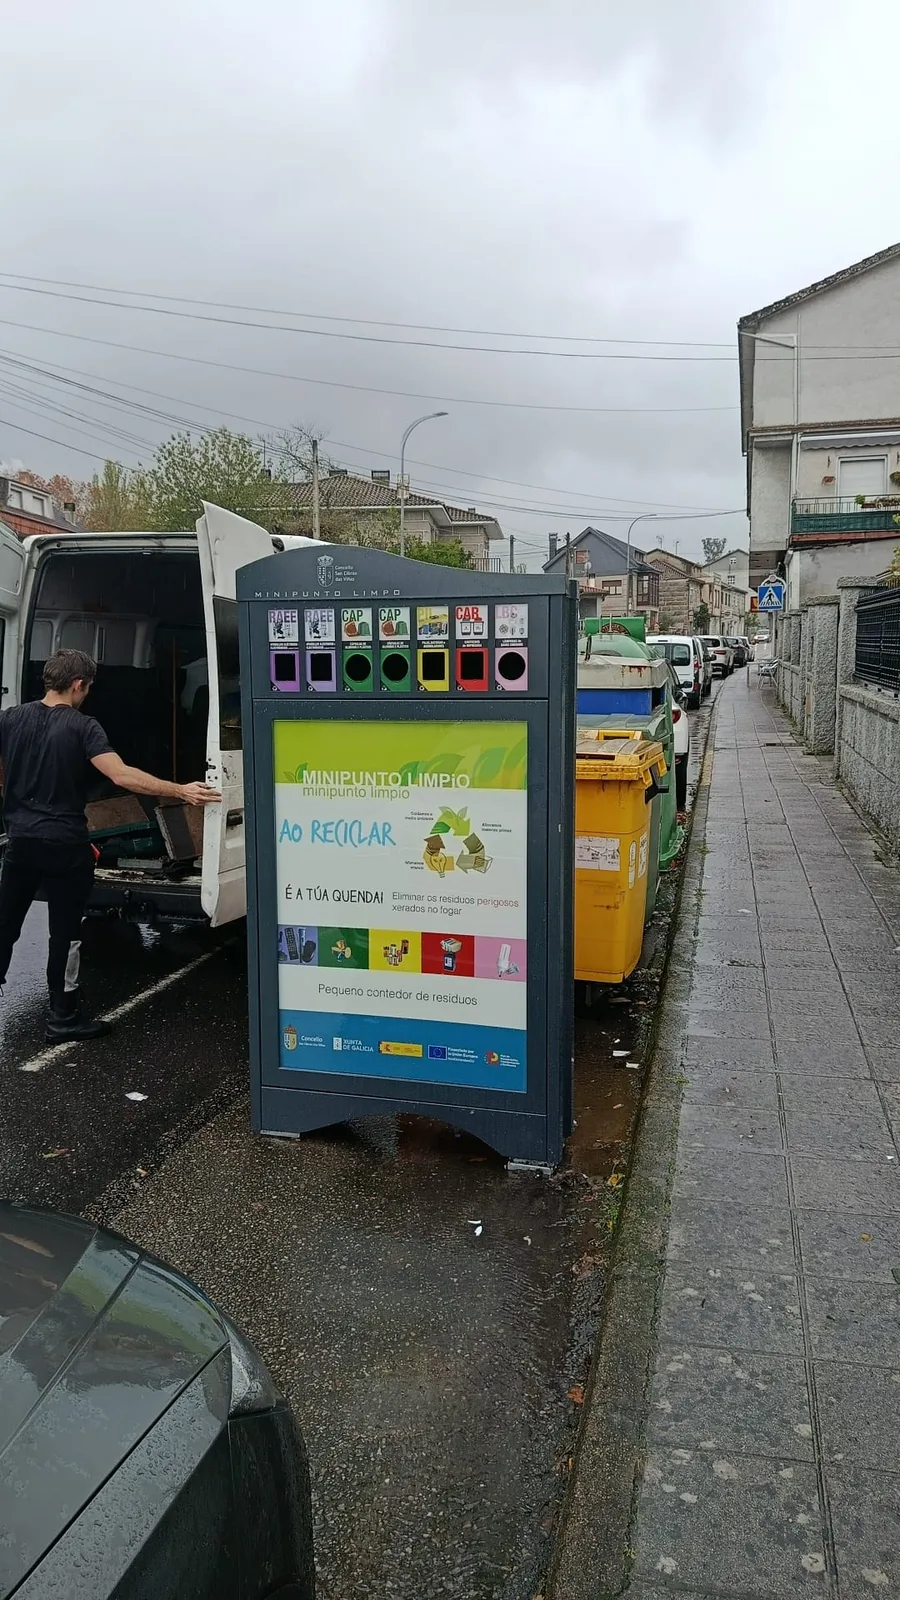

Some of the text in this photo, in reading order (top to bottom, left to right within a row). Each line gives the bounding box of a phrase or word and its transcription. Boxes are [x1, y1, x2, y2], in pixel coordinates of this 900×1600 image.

[255, 589, 401, 598] MINIPUNTO LIMPO
[269, 610, 297, 623] RAEE
[305, 610, 333, 623] RAEE
[342, 609, 363, 622] CAP
[379, 608, 401, 622] CAP
[302, 770, 402, 786] MINIPUNTO
[302, 786, 410, 801] minipunto limpio
[311, 819, 396, 847] RECICLAR
[285, 884, 292, 900] É
[296, 888, 303, 900] A
[306, 885, 329, 901] TÚA
[392, 891, 424, 902] Eliminar
[439, 895, 475, 904] residuos
[477, 897, 519, 909] perigosos
[392, 903, 463, 917] xerados no fogar
[318, 984, 478, 1006] Pequeno contedor de residuos
[300, 1035, 323, 1043] Concello
[343, 1038, 363, 1046] XUNTA
[352, 1045, 374, 1053] GALICIA
